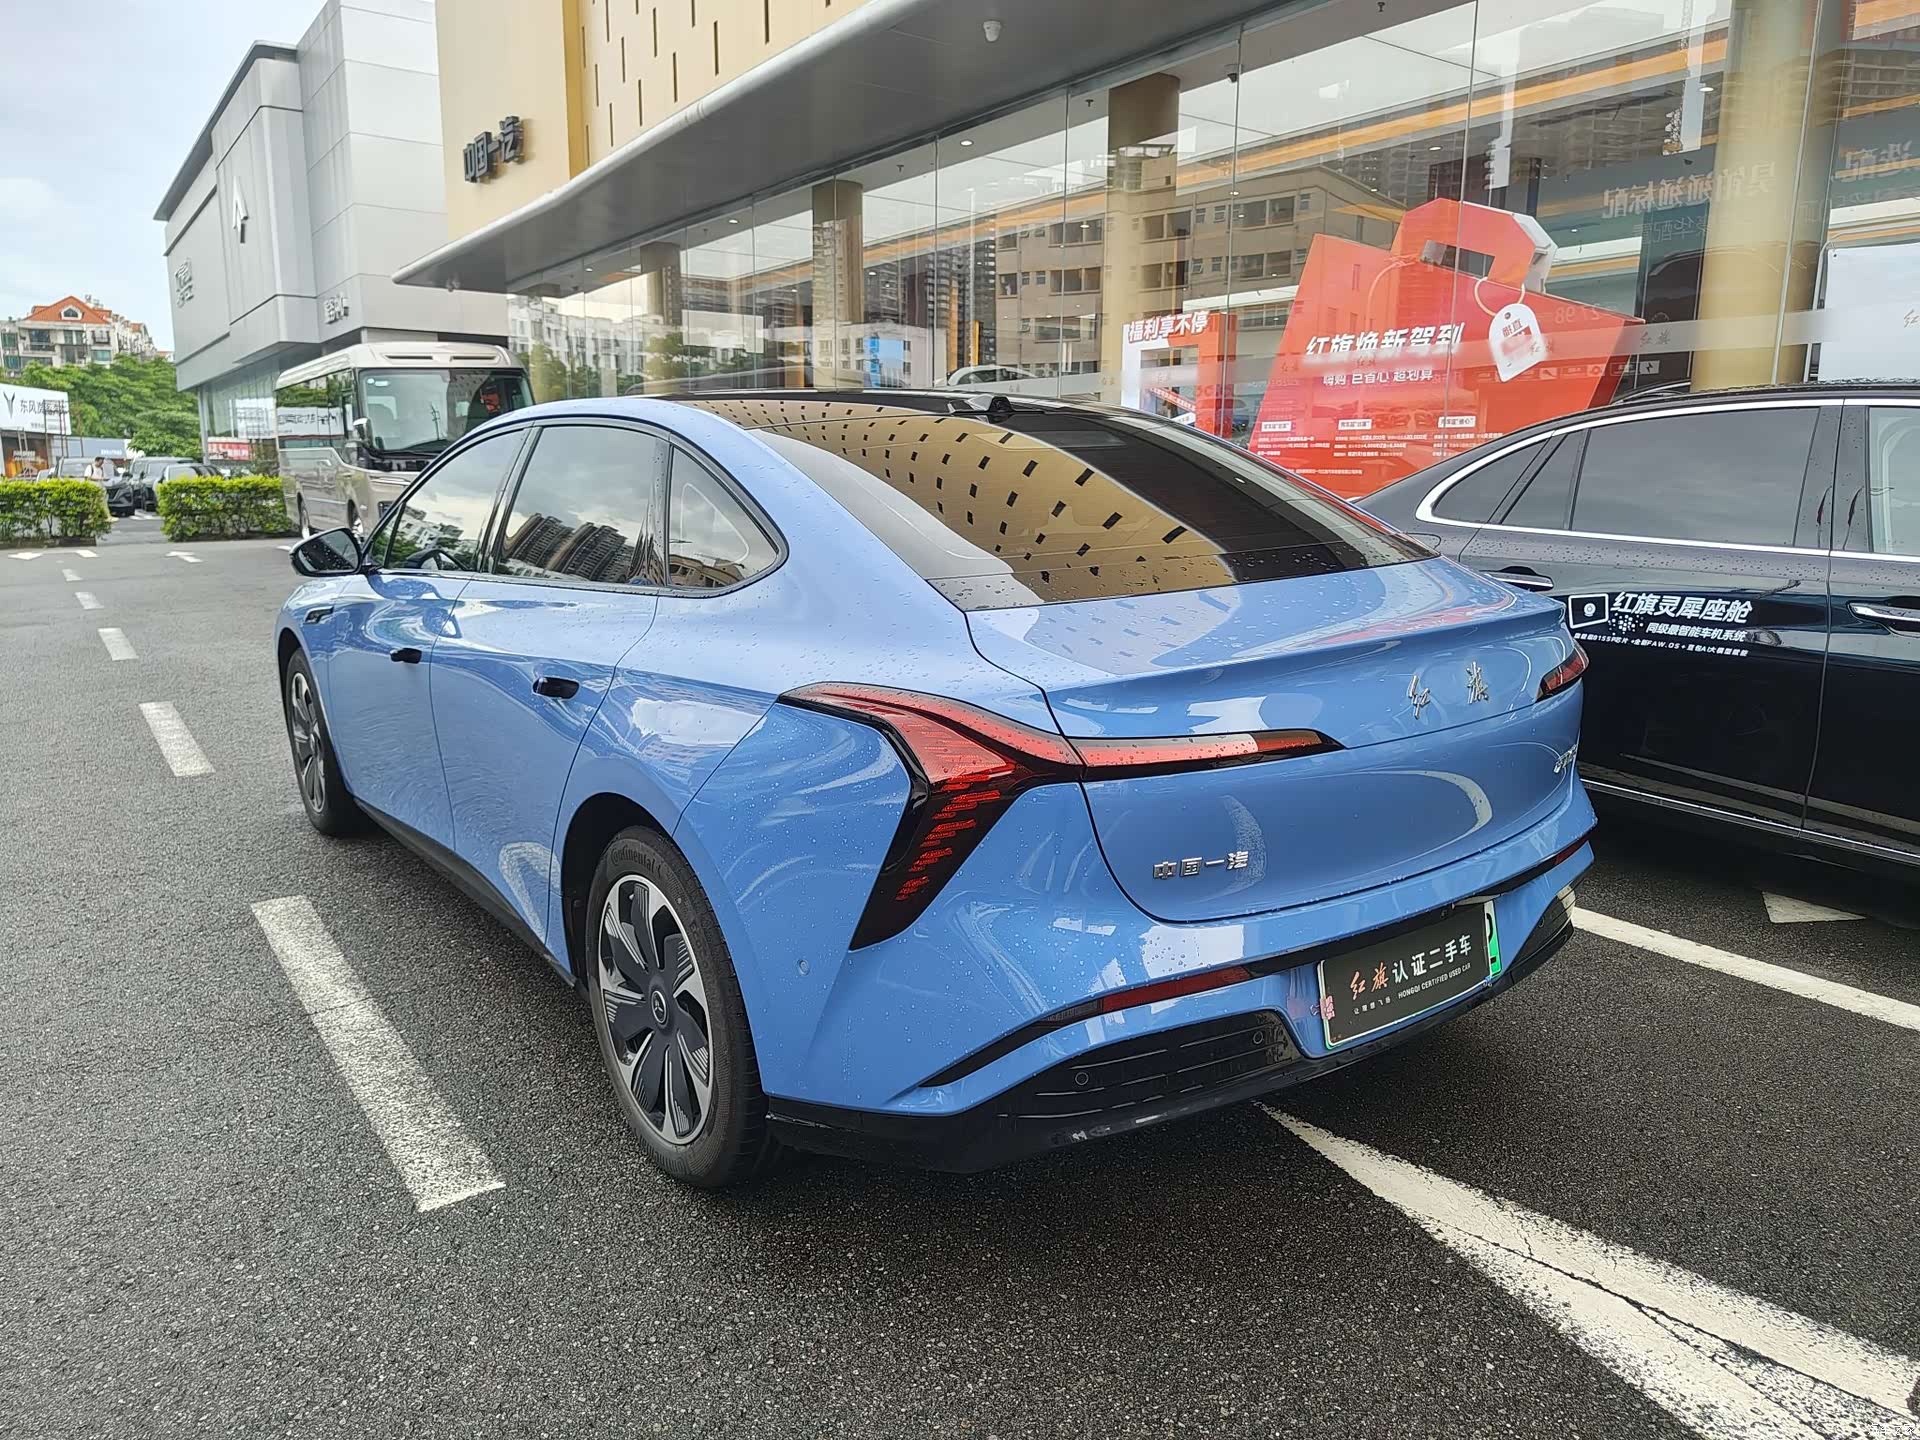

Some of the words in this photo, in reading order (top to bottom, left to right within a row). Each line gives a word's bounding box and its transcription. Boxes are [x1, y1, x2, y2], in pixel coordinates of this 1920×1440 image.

[464, 116, 522, 183] 中国一汽
[1128, 310, 1209, 343] 福利享不停
[1306, 322, 1465, 361] 红旗焕新驾到
[1611, 592, 1752, 624] 红旗灵犀座舱
[1646, 622, 1748, 643] 同级最智能车机系统
[1152, 850, 1249, 880] 中国一汽
[1350, 934, 1473, 1001] 红旗认证二手车
[1398, 985, 1421, 999] HONGQI
[1421, 973, 1448, 990] CERTIFIED
[1448, 967, 1461, 978] USED
[1462, 962, 1471, 972] CAR
